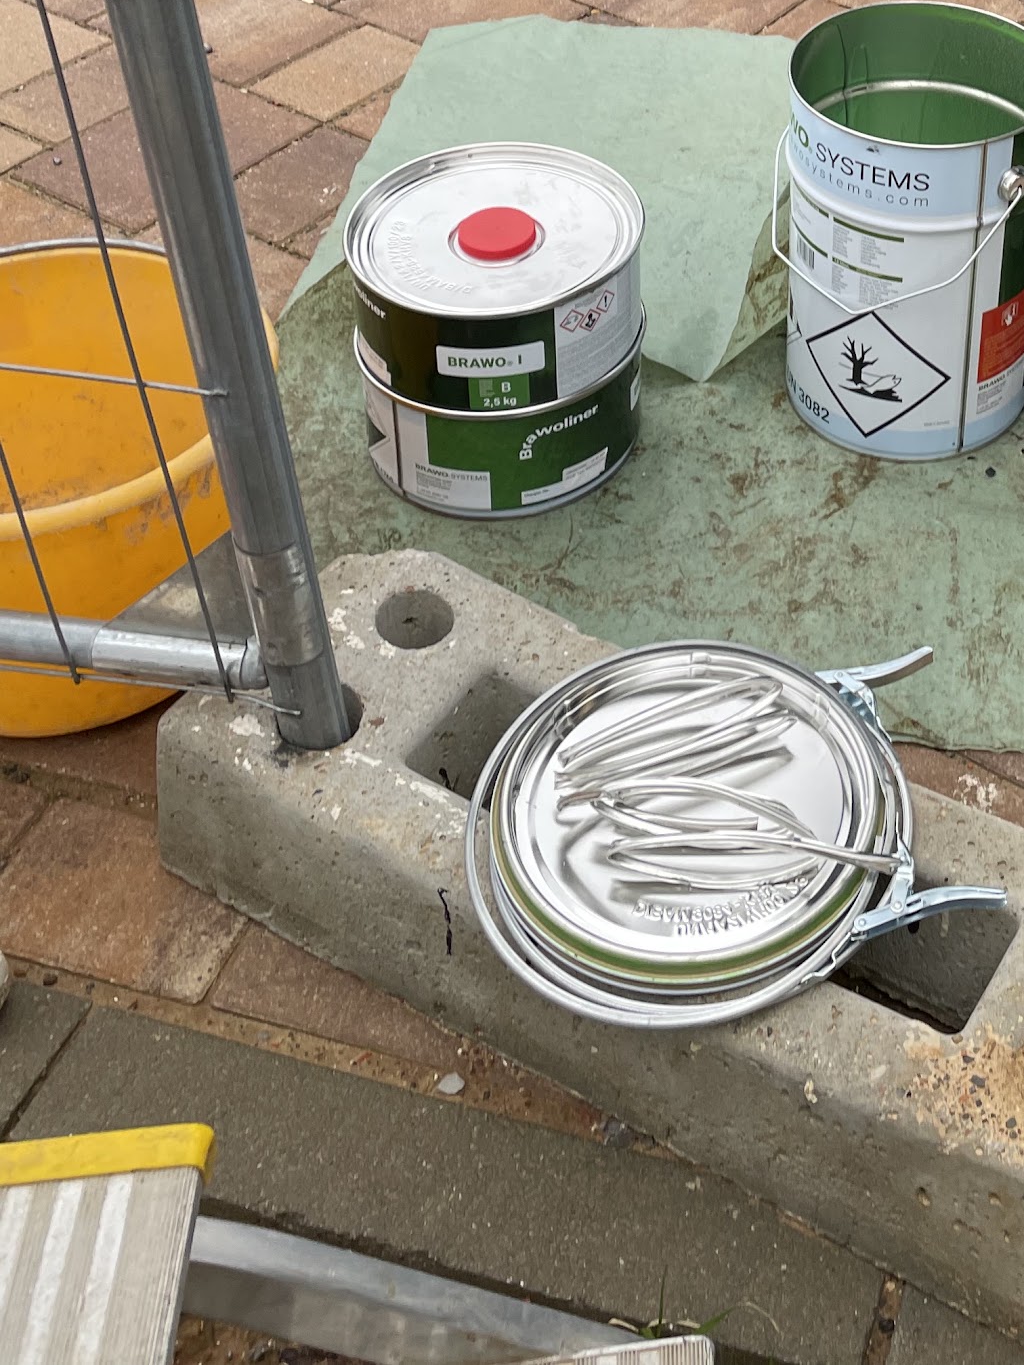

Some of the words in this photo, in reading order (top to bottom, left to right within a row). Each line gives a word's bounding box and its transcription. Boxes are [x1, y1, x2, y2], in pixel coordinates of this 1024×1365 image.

[815, 142, 930, 192] SYSTEMS
[447, 356, 507, 368] BRAWO
[501, 381, 511, 393] B
[503, 395, 517, 406] kg
[798, 387, 830, 424] 3082
[519, 403, 600, 460] Brawoliner
